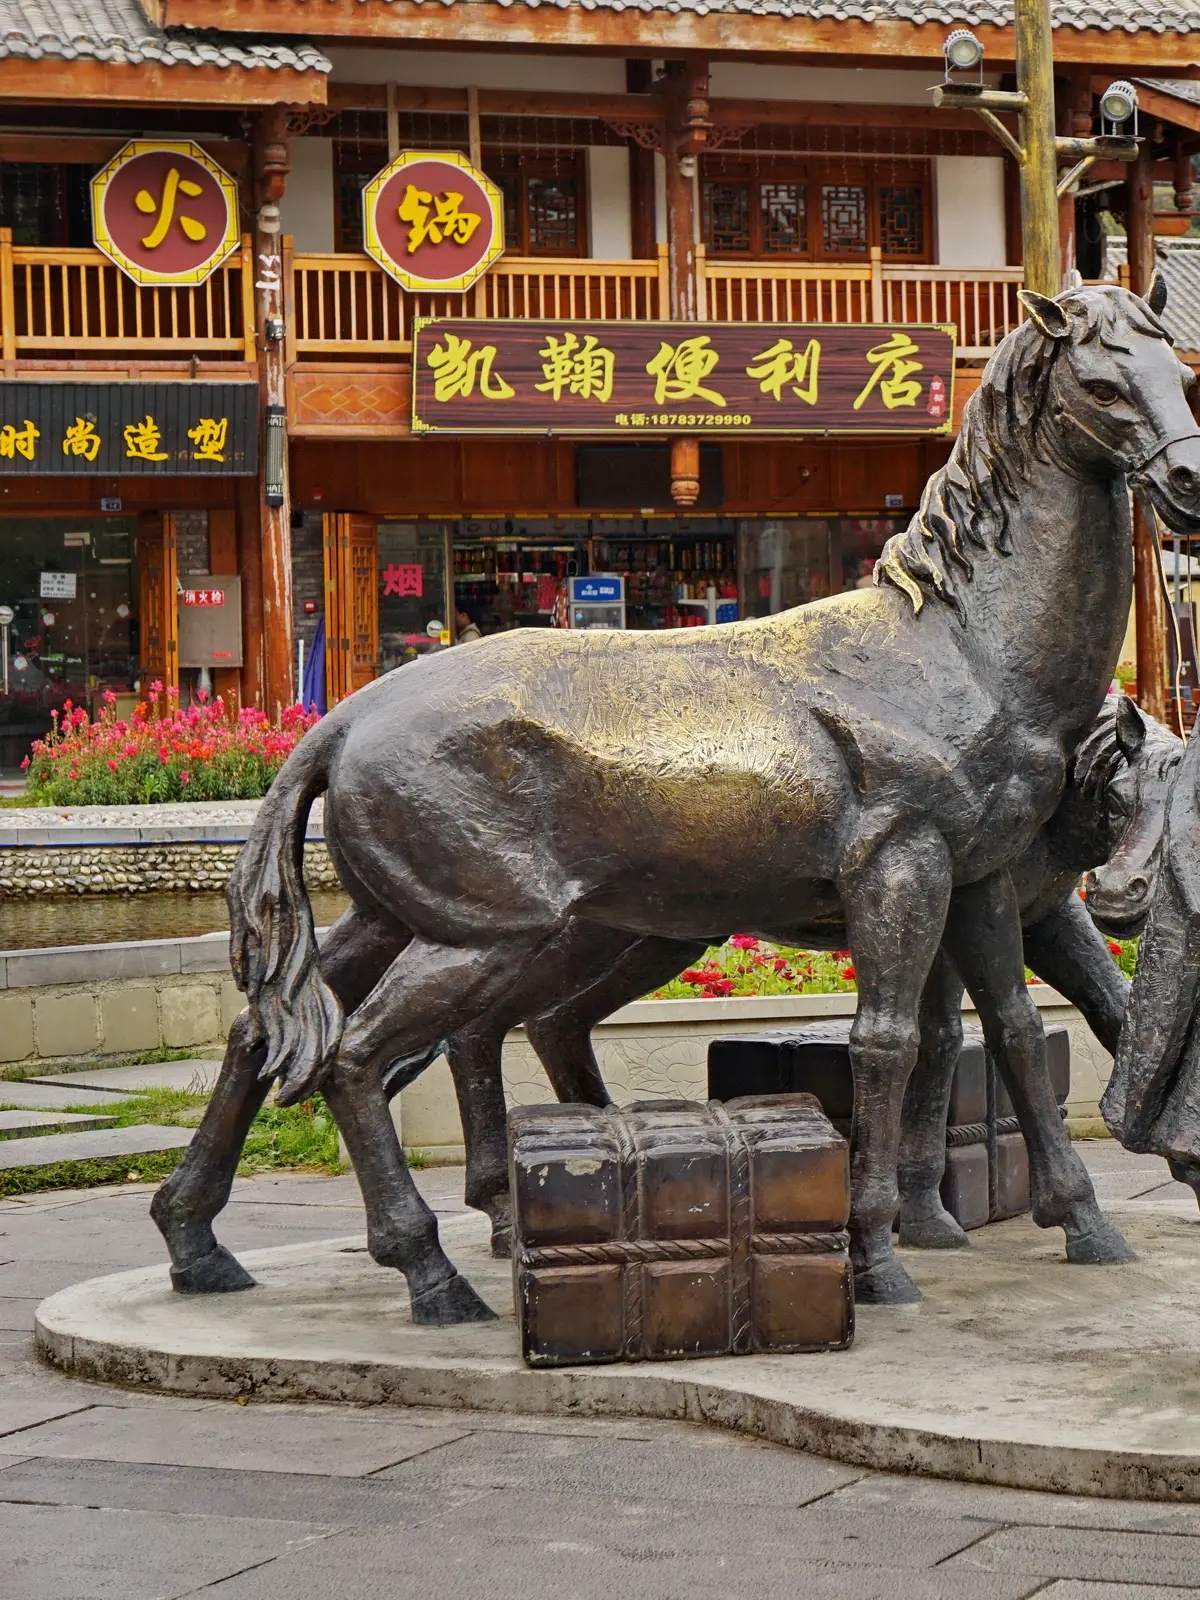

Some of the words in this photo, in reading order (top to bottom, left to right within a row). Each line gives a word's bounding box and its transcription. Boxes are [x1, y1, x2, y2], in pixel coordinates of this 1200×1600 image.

[135, 168, 207, 248] 火
[397, 184, 482, 254] 锅
[427, 332, 924, 410] 凯鞠便利店
[0, 415, 228, 462] 时尚造型
[185, 590, 222, 604] 消火栓
[382, 563, 423, 597] 烟
